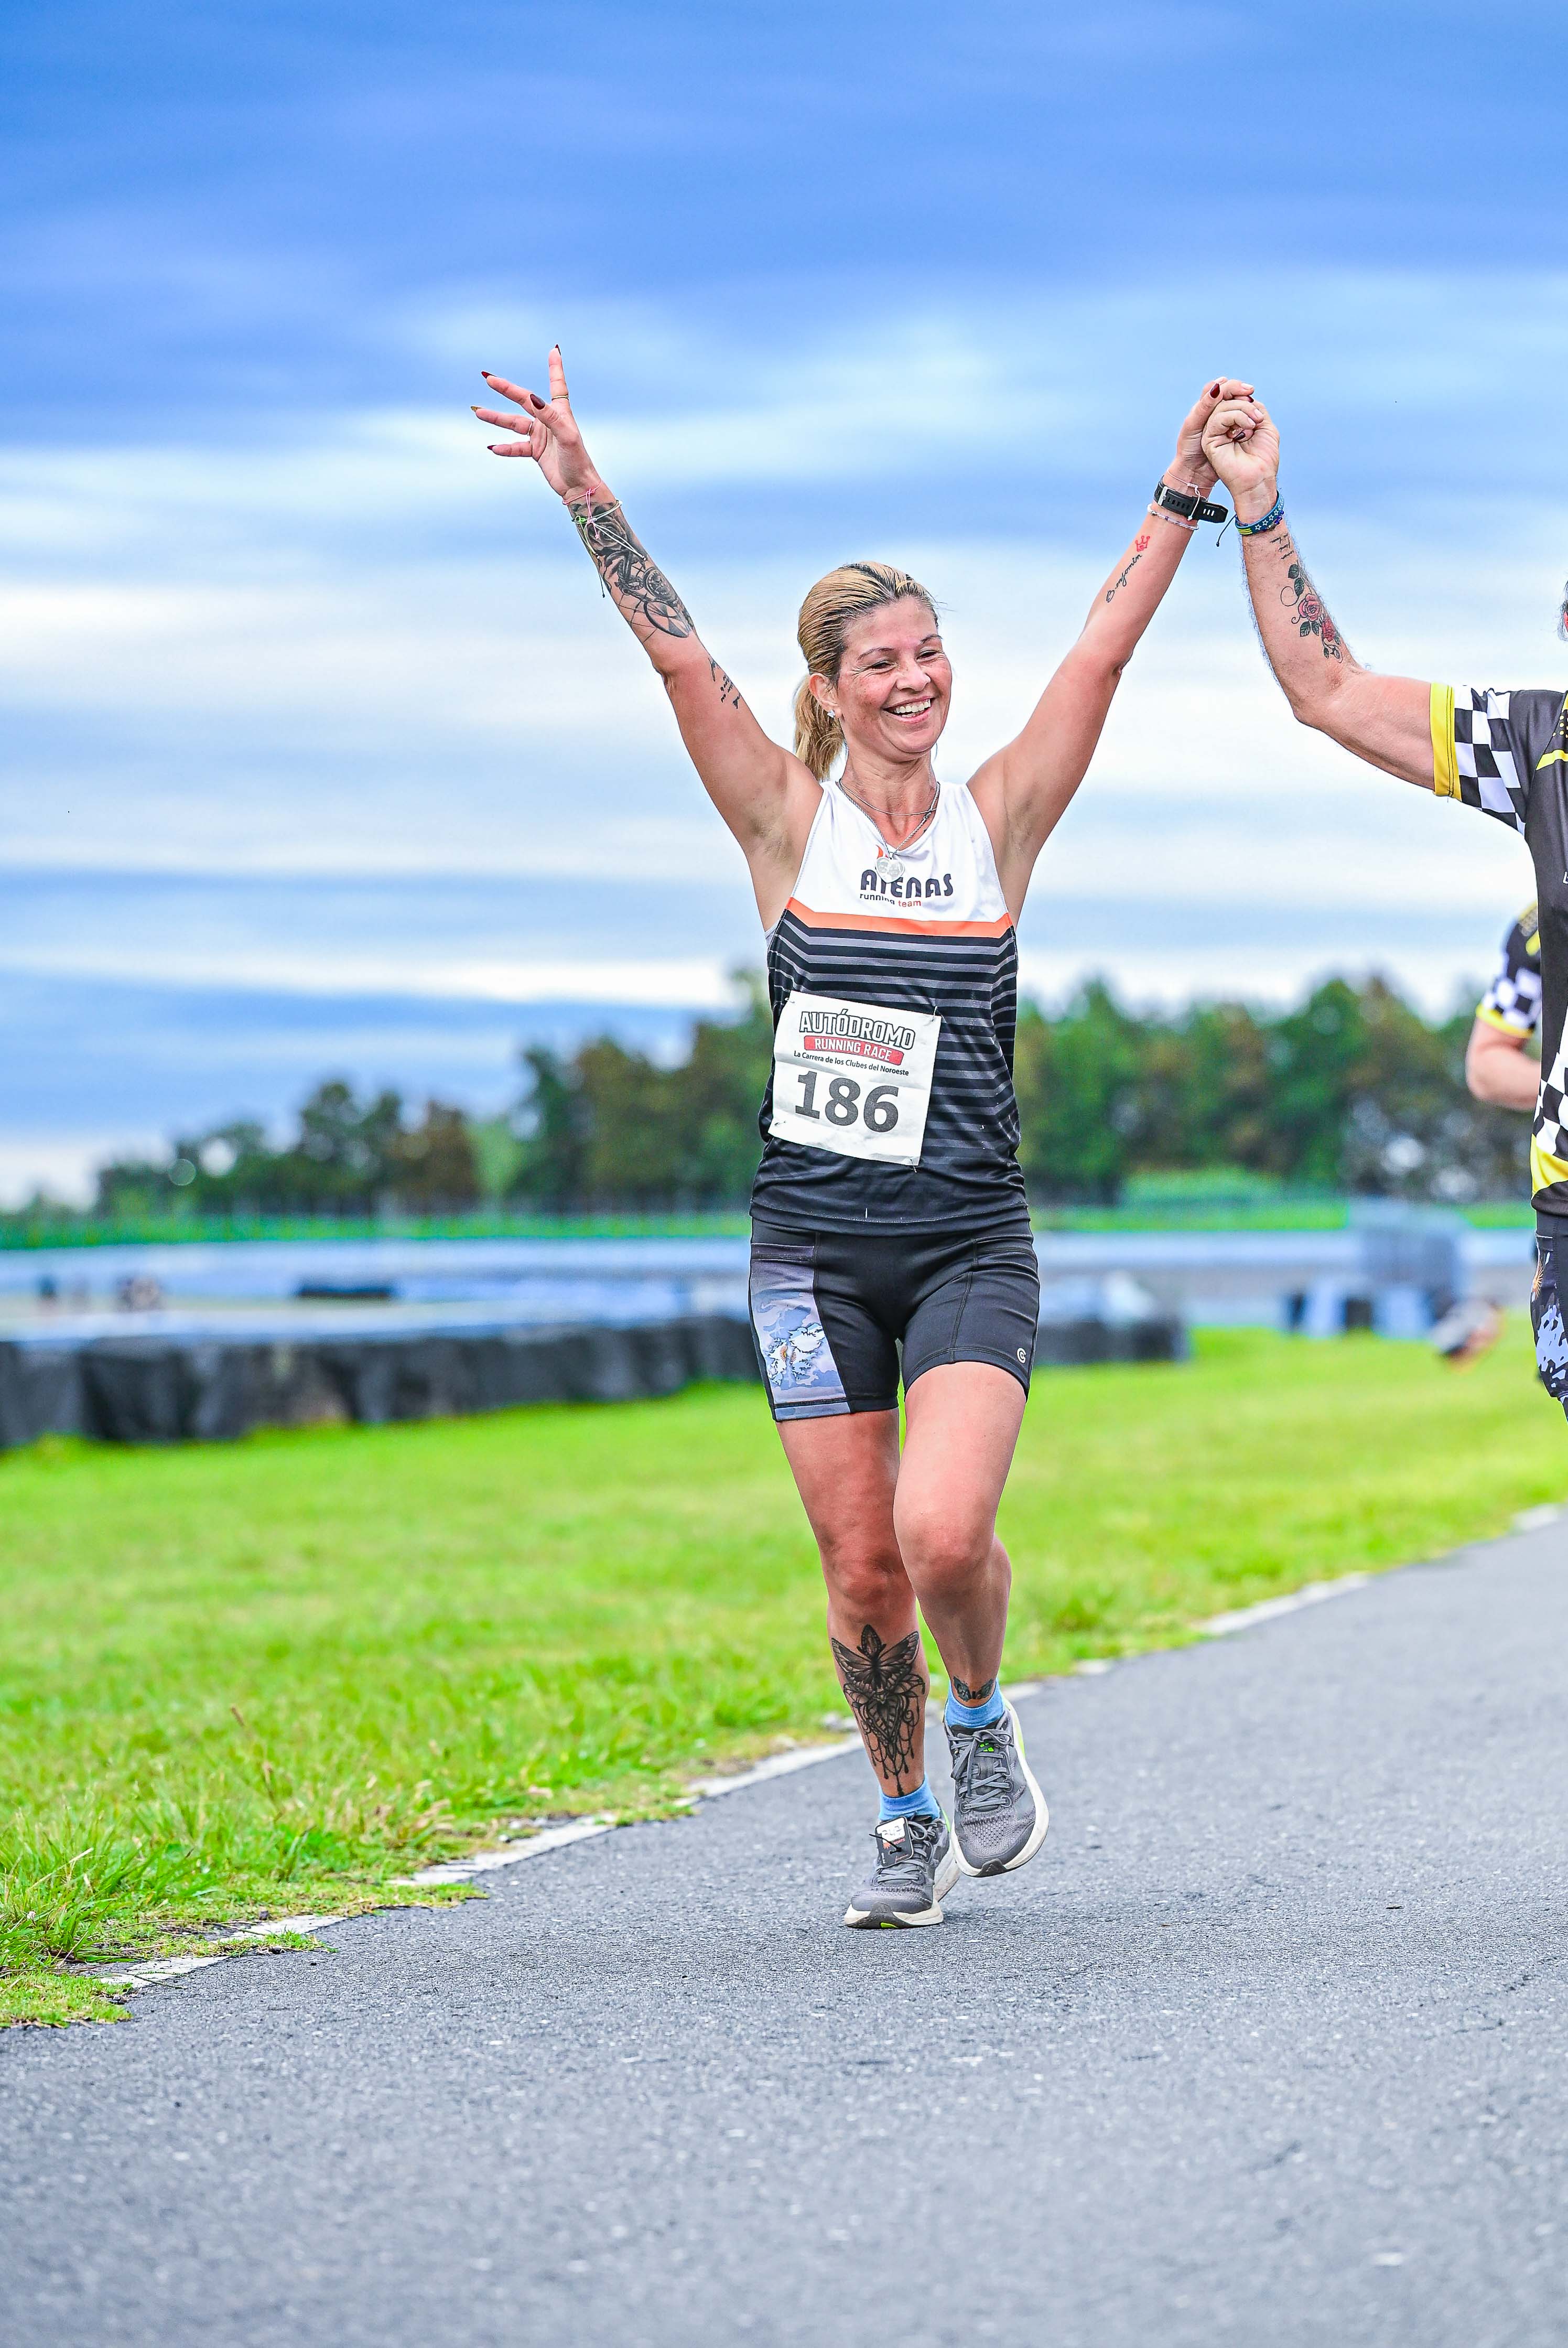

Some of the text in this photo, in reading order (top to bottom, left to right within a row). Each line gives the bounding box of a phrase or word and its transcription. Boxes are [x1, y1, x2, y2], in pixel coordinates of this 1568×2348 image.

[799, 1009, 915, 1050] AUTÓDROMO
[802, 1052, 824, 1061] Carrera
[846, 1060, 867, 1069] Clubes
[880, 1065, 909, 1076] Noroeste
[815, 1038, 892, 1061] RUNNING RACE
[795, 1071, 899, 1132] 186
